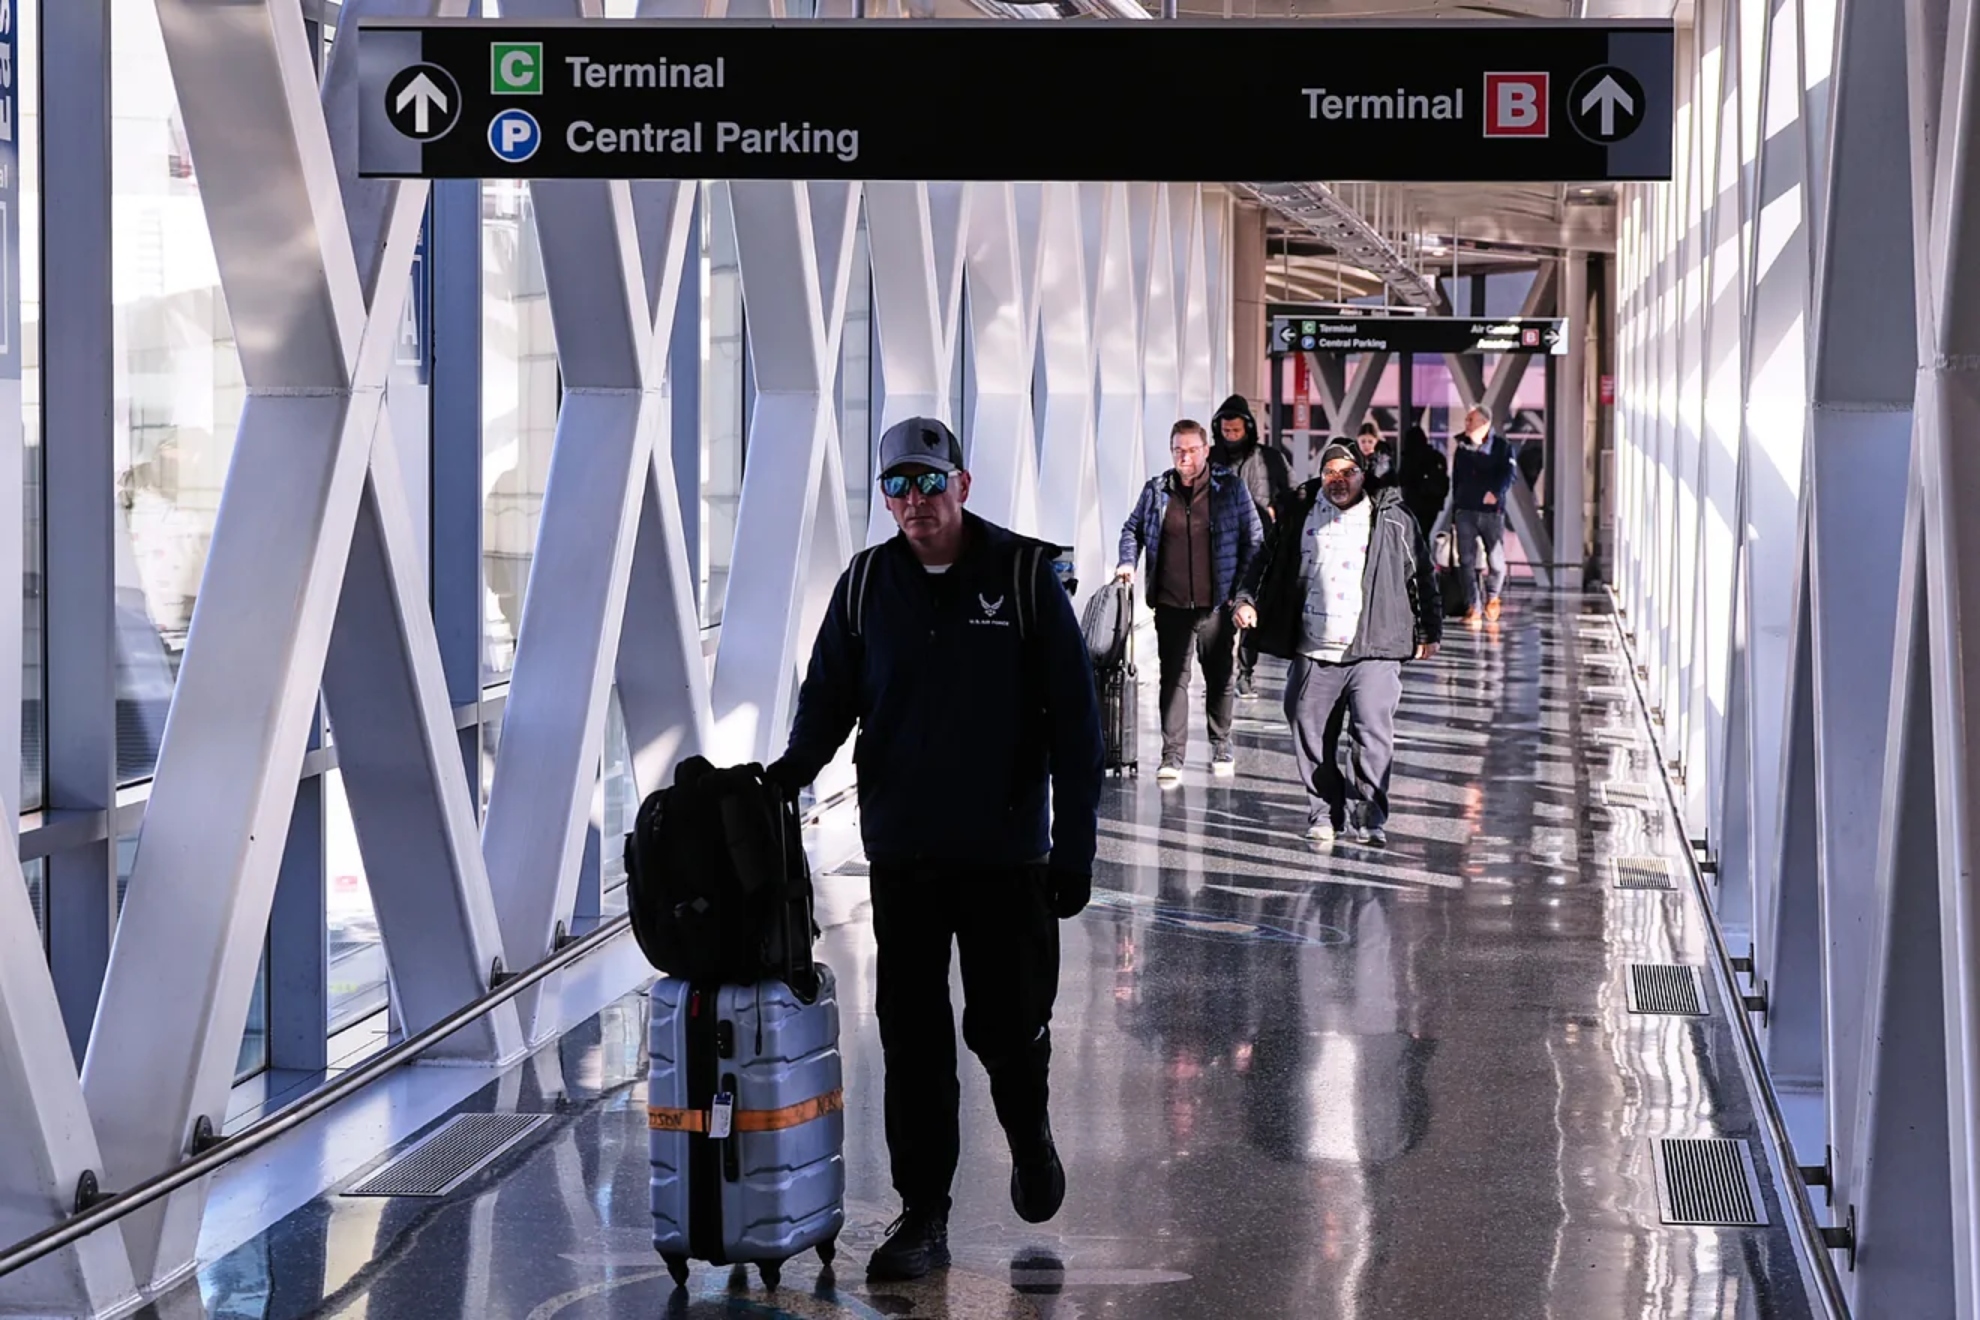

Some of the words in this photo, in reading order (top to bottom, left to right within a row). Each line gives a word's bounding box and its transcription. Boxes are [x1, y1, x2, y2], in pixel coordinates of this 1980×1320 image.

[500, 51, 534, 87] C
[566, 57, 725, 88] Terminal
[1302, 88, 1463, 119] Terminal
[1497, 82, 1538, 127] B
[566, 122, 702, 153] Central
[716, 122, 860, 162] Parking
[1319, 324, 1356, 333] Terminal
[1470, 324, 1485, 334] Air
[1319, 339, 1351, 348] Central
[1353, 339, 1387, 350] Parking
